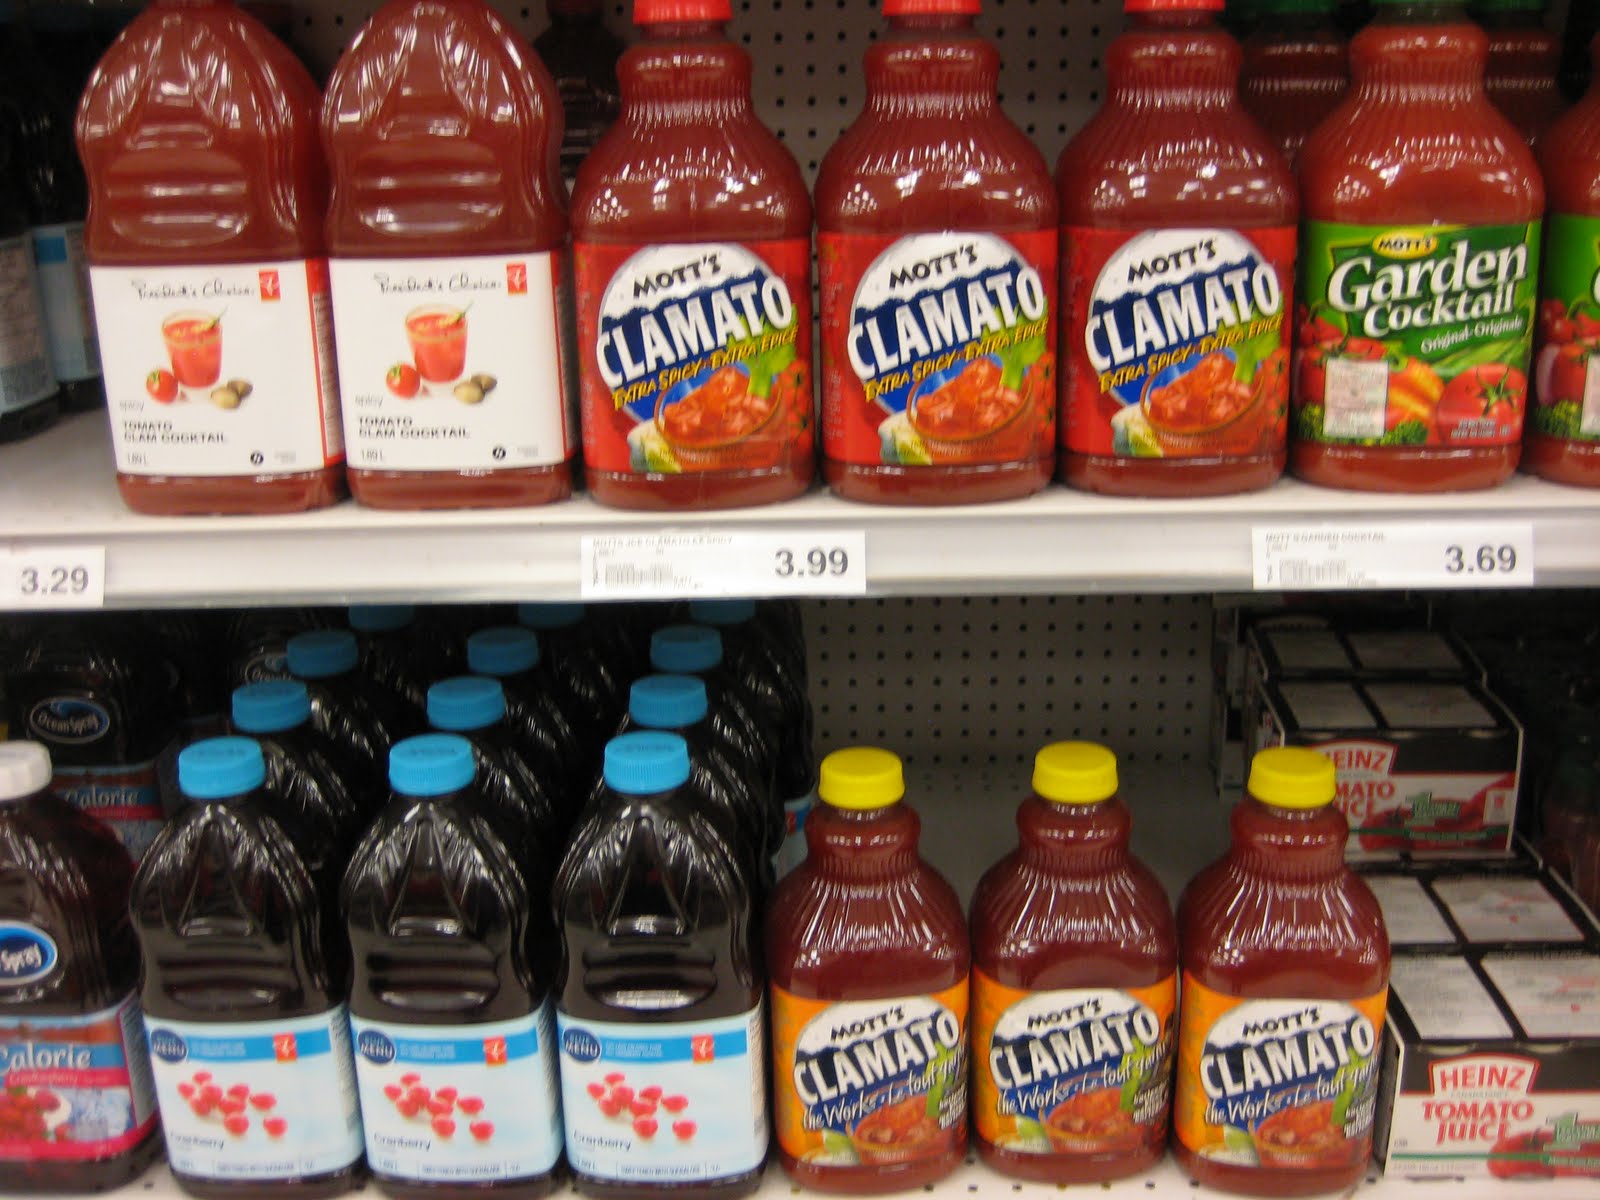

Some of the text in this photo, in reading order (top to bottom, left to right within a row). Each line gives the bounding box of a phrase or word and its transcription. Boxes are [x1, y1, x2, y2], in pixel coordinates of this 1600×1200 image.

[1377, 235, 1433, 251] MOTT'S
[633, 252, 722, 297] MOTT'S
[889, 242, 978, 288] MOTT'S
[1128, 238, 1217, 283] MOTT'S
[1327, 240, 1528, 313] Garden
[848, 266, 1044, 379] CLAMATO
[1085, 262, 1280, 369] CLAMATO
[1363, 280, 1517, 338] Cocktail
[597, 275, 793, 388] CLAMATO
[1421, 314, 1523, 354] Original Originale
[864, 372, 911, 403] EXTRA
[912, 351, 956, 382] SPICY
[965, 334, 1011, 360] EXTRA
[1099, 363, 1146, 393] EXTRA
[1147, 344, 1192, 374] SPICY
[1200, 329, 1245, 355] EXTRA
[611, 381, 657, 411] EXTRA
[659, 360, 702, 390] SPICY
[709, 344, 757, 369] EXTRA
[124, 420, 172, 432] TOMATO
[161, 432, 229, 443] COCKTAIL
[359, 416, 413, 428] TOMATO
[359, 427, 471, 439] CLAM COCKTAIL
[774, 546, 849, 578] 3.99
[1445, 544, 1517, 574] 3.69
[20, 567, 89, 595] 3.29
[1331, 750, 1387, 771] EINZ
[1335, 780, 1396, 800] MATO
[831, 1005, 905, 1041] MOTT'S
[1027, 998, 1101, 1030] MOTT'S
[1242, 1007, 1320, 1038] MOTT'S
[565, 1040, 598, 1057] MENU
[794, 1011, 959, 1106] CLAMATO
[990, 1006, 1160, 1088] CLAMATO
[1200, 1016, 1374, 1099] CLAMATO
[1439, 1063, 1526, 1090] HEINZ
[1422, 1100, 1534, 1121] TOMATO
[573, 1130, 632, 1152] Cranberry
[1436, 1121, 1511, 1145] JUICE
